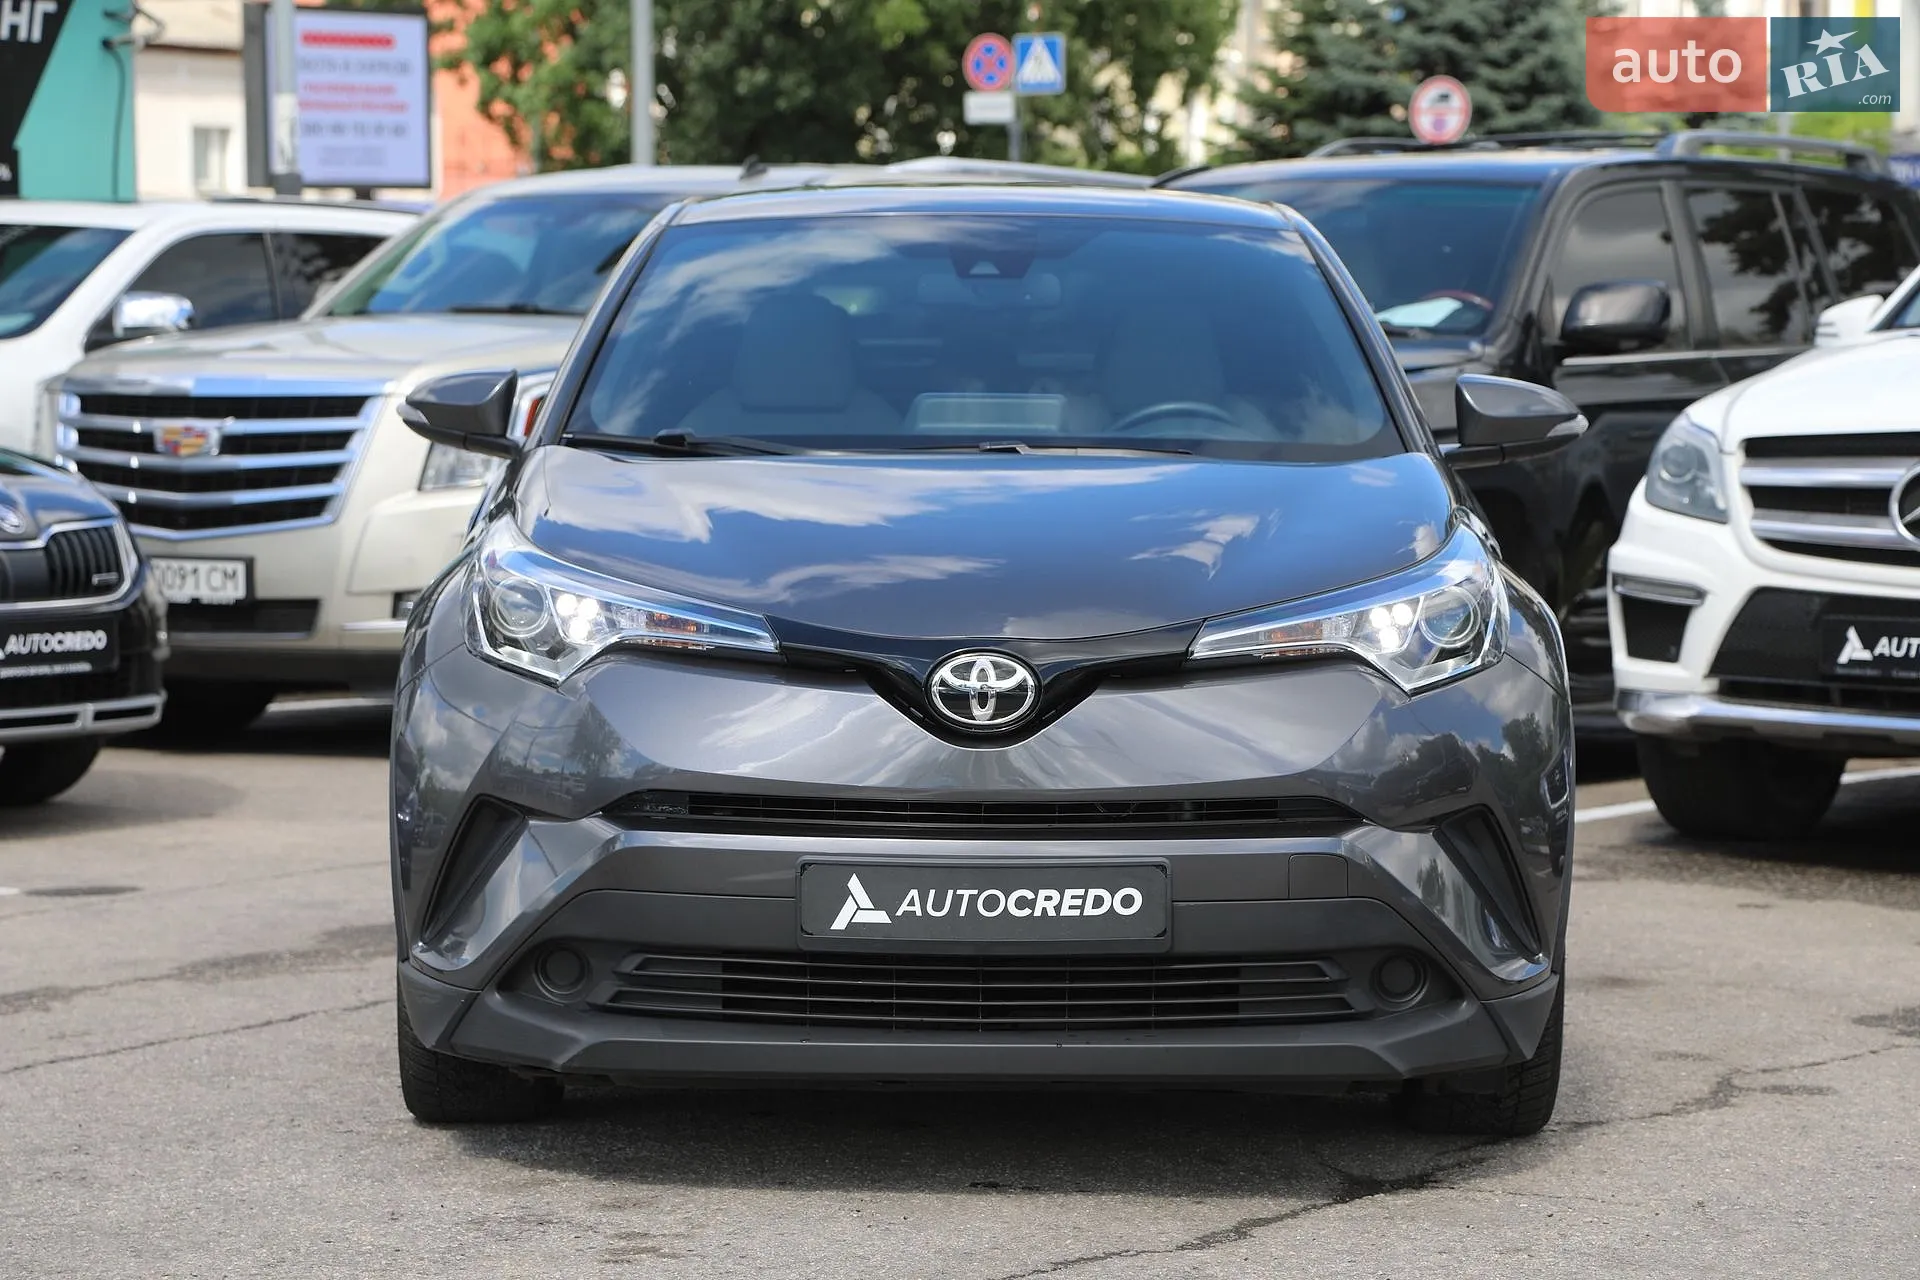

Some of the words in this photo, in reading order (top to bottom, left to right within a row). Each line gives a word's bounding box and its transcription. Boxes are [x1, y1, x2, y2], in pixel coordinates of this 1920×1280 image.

[205, 565, 240, 593] CM
[4, 629, 107, 655] AUTOCREDO
[1872, 636, 1920, 658] AUT
[895, 887, 1143, 917] AUTOCREDO
